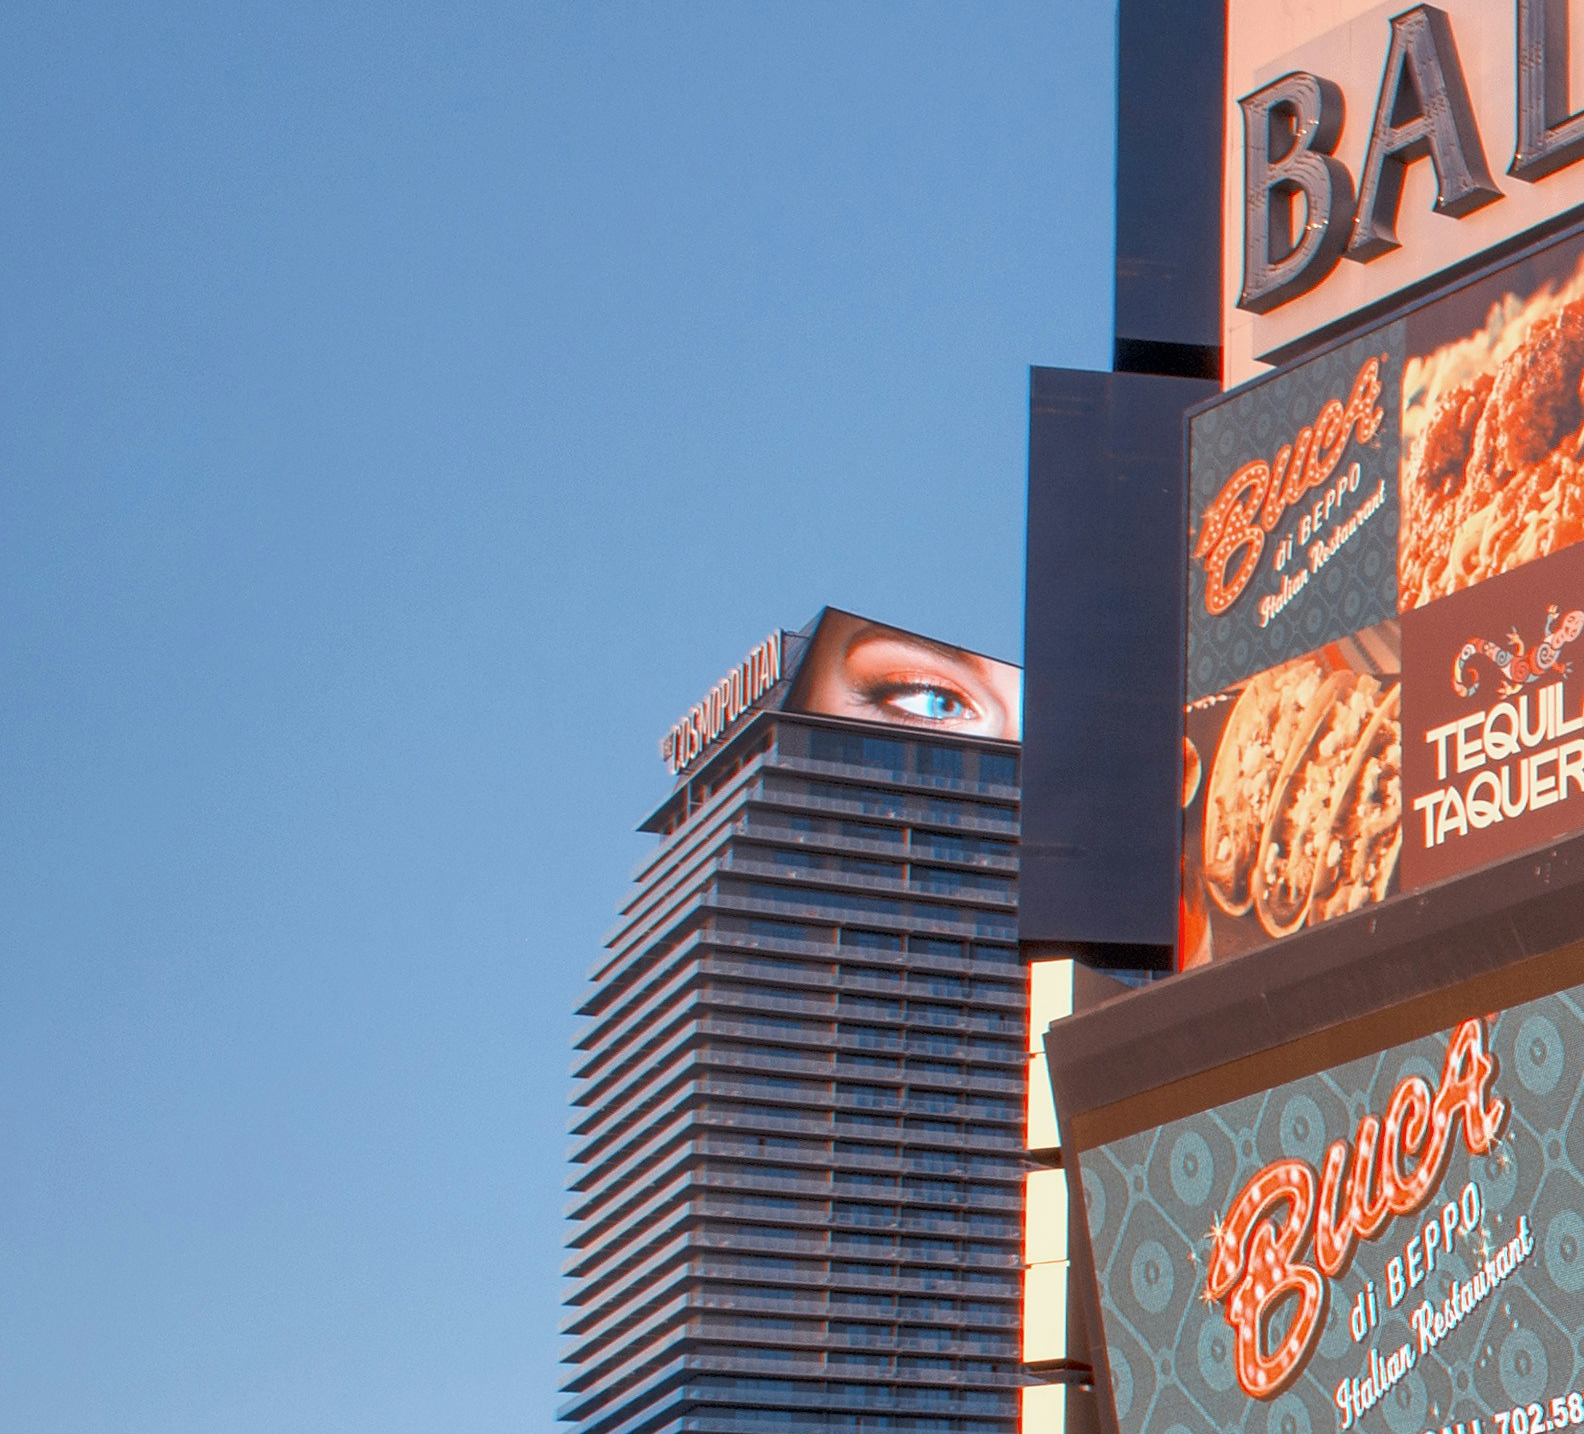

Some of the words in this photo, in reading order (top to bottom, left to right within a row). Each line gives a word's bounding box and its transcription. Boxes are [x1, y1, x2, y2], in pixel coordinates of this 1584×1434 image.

[1259, 568, 1308, 628] Italian
[1308, 479, 1386, 574] Restaurant
[1274, 533, 1293, 571] di
[1299, 462, 1361, 546] BEPPO
[1334, 1343, 1416, 1429] Italian
[1409, 1215, 1534, 1355] Restaurant
[1350, 1281, 1377, 1342] di
[1385, 1182, 1483, 1308] BEPPO
